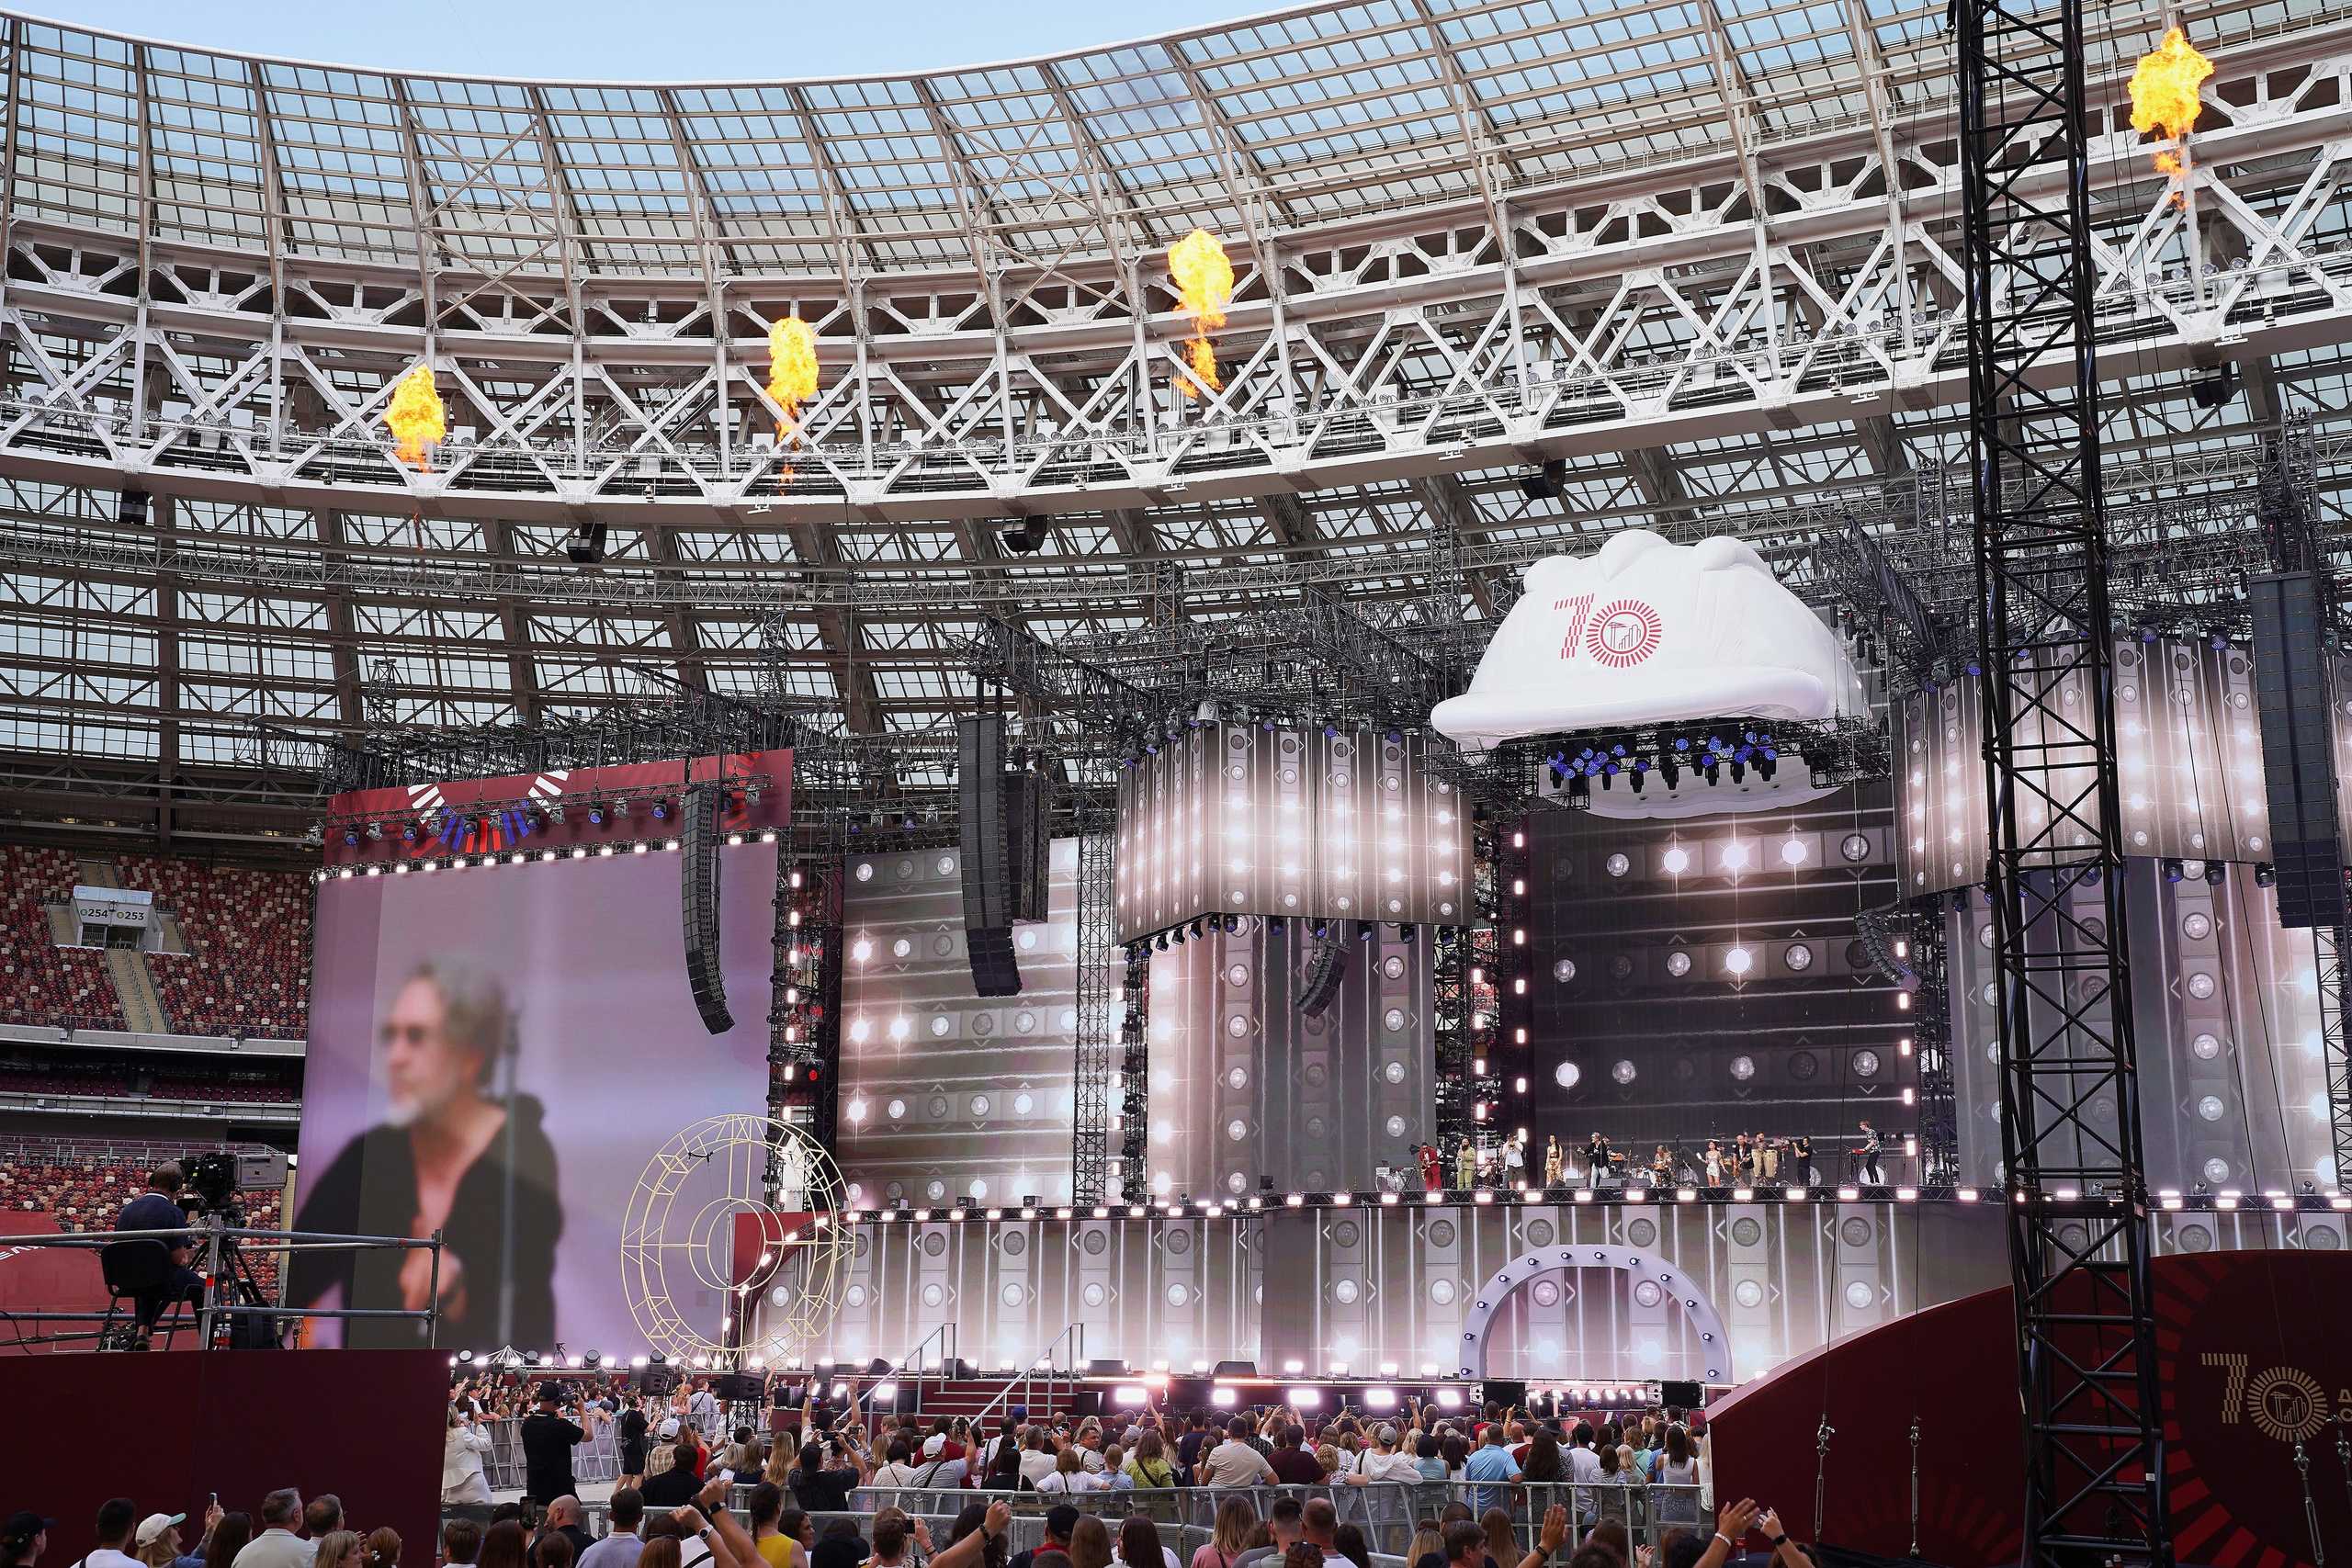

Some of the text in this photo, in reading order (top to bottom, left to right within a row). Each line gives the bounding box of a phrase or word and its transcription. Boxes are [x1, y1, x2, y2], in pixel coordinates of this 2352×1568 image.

[1554, 593, 1662, 668] 70
[88, 908, 107, 918] 254
[124, 911, 144, 920] 253
[2201, 1352, 2328, 1442] 70
